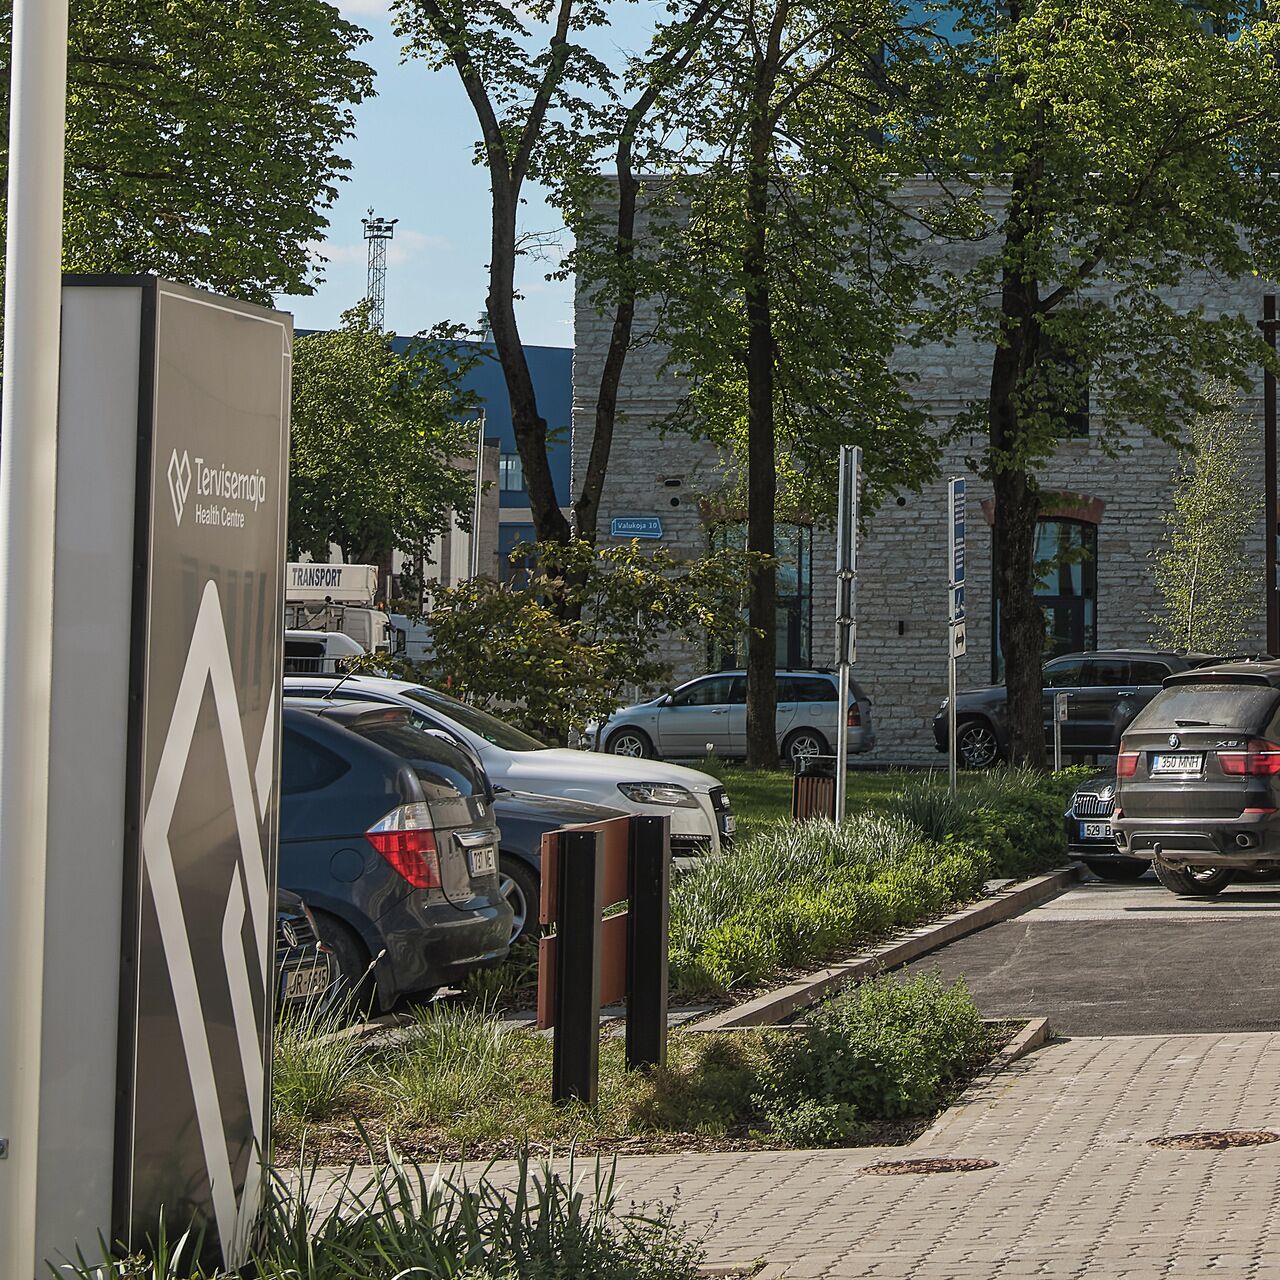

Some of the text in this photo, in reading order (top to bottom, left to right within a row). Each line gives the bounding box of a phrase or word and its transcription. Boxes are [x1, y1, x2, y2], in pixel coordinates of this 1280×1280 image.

[195, 457, 266, 512] Tervisemaja
[195, 503, 245, 528] Health Centre
[617, 522, 647, 530] Valukoja
[292, 567, 342, 588] TRANSPORT
[1162, 755, 1177, 768] 350
[1086, 824, 1100, 836] 529
